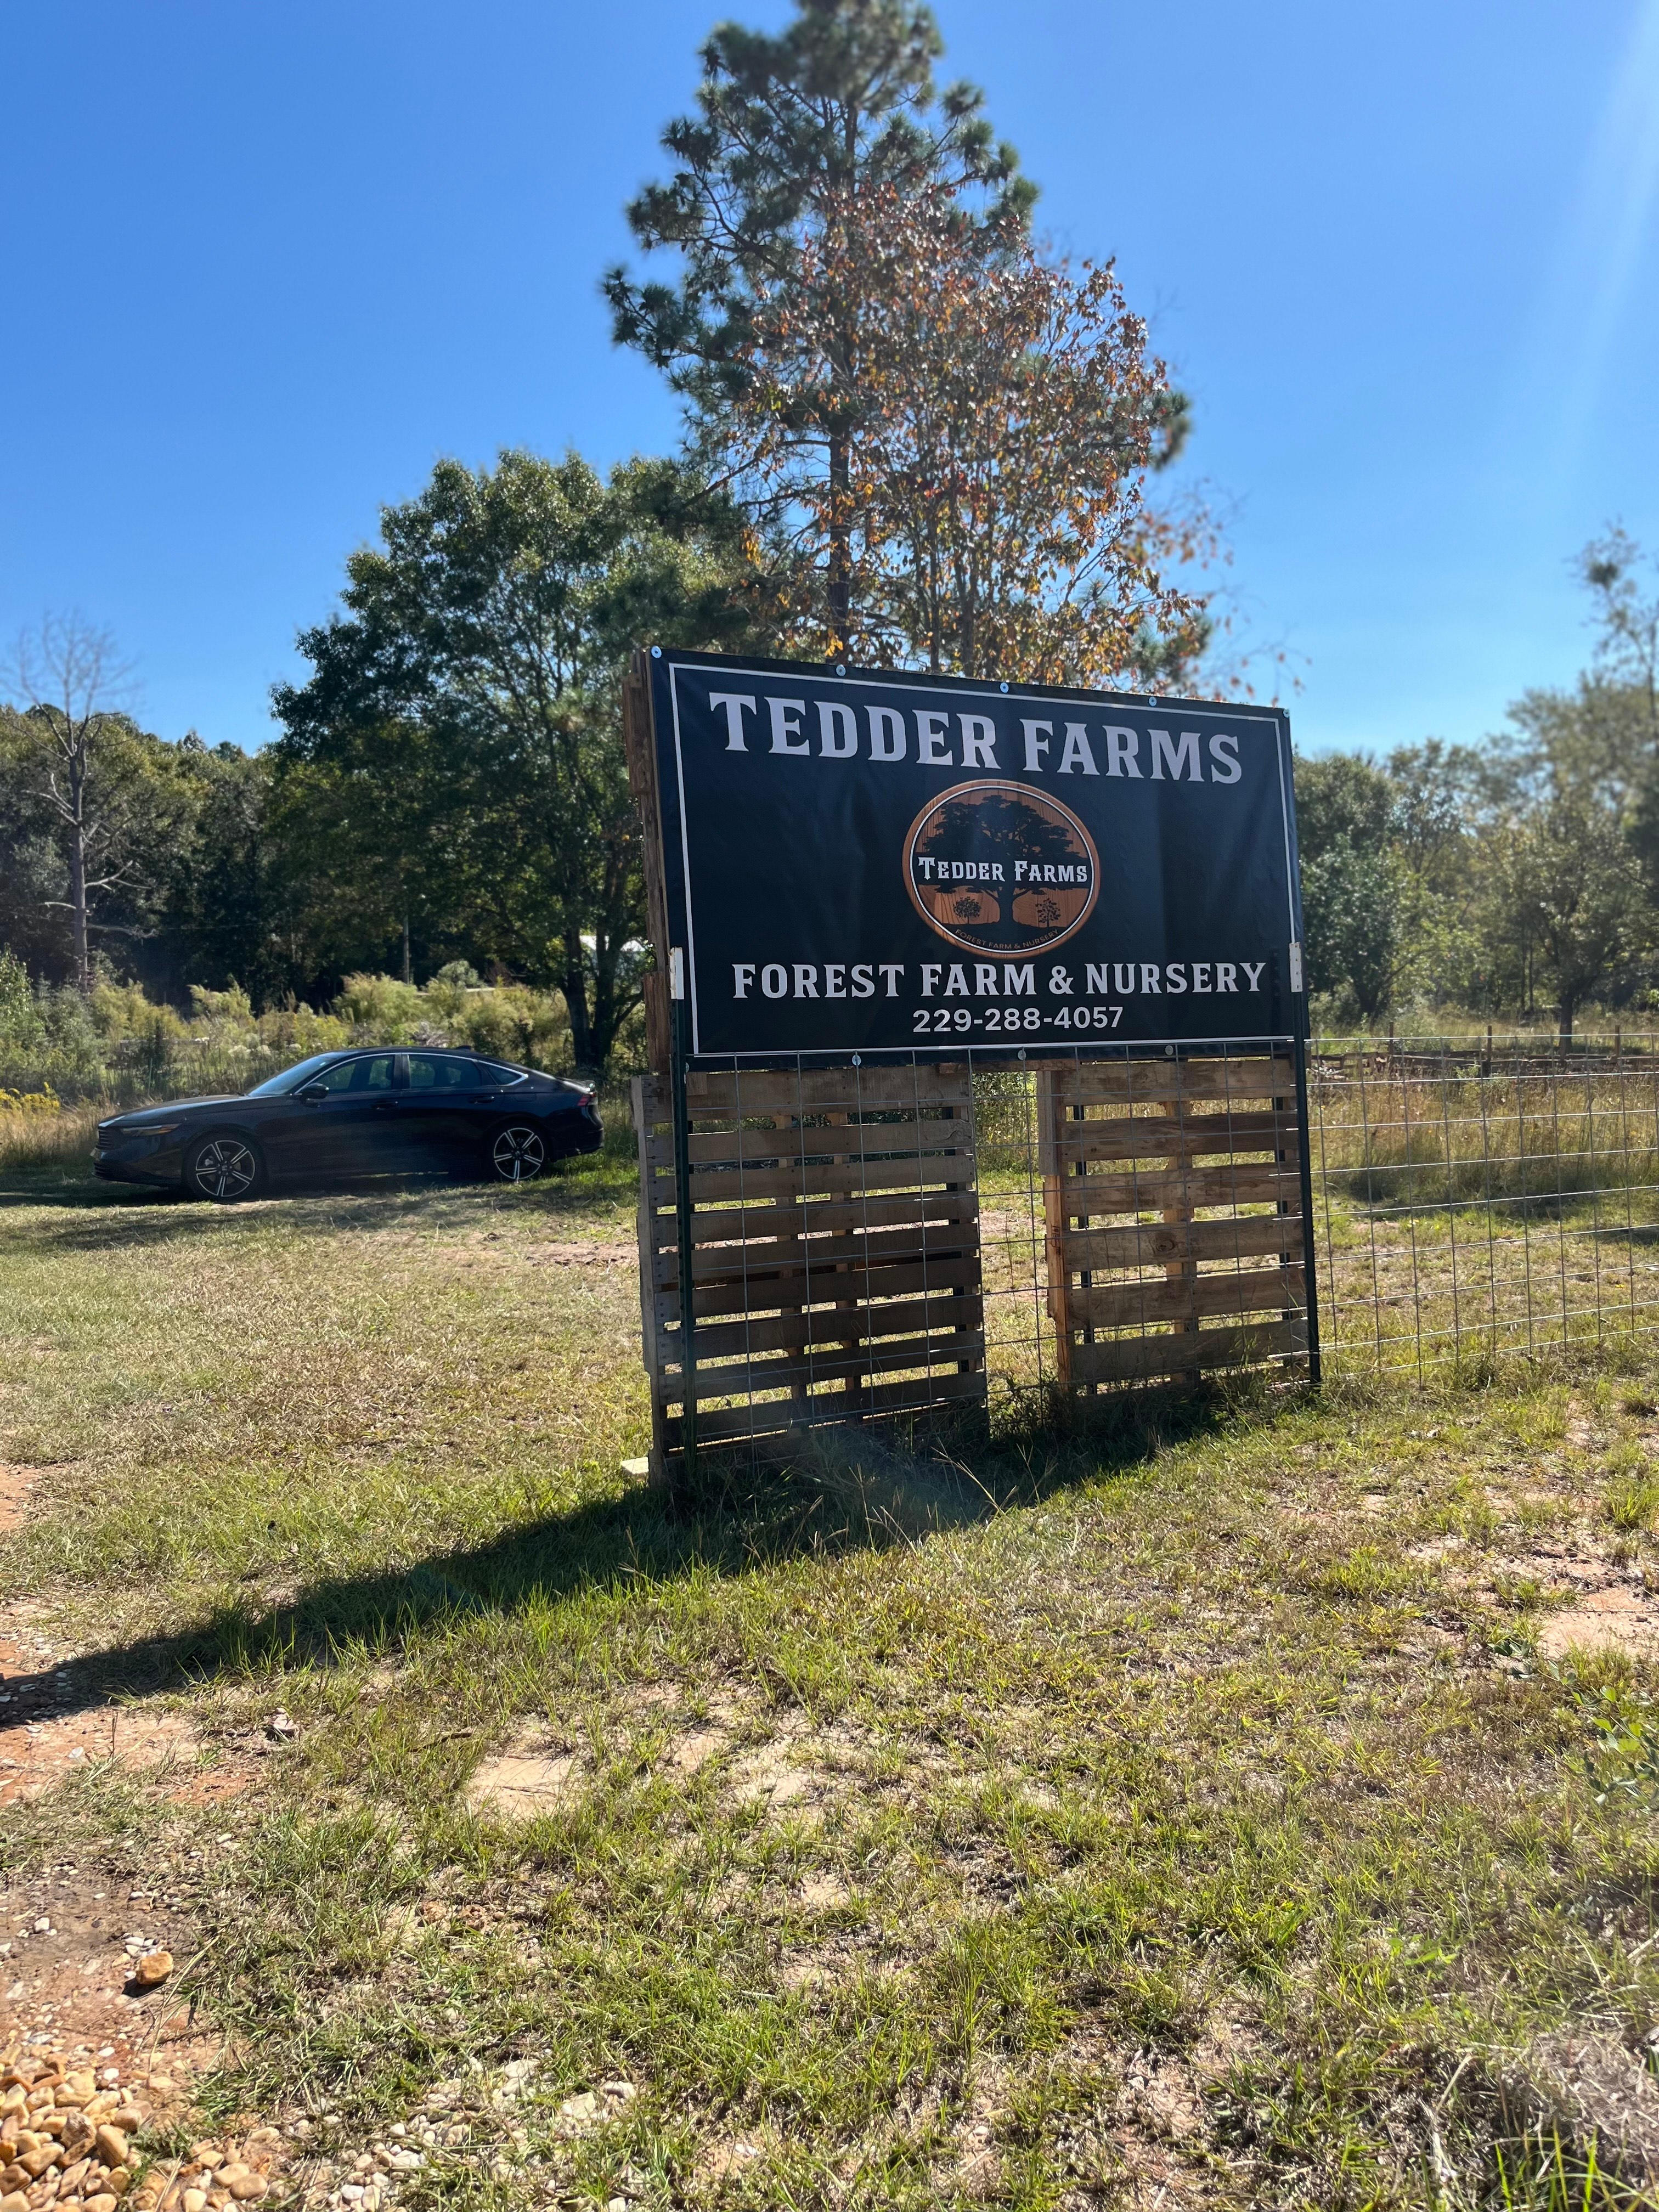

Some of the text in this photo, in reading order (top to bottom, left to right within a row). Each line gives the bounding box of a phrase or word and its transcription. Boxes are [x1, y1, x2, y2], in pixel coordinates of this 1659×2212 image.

[709, 692, 1243, 785] TEDDER FARMS
[955, 929, 987, 945] FOREST
[1023, 928, 1058, 947] NURSERY
[732, 962, 1266, 998] FOREST FARM & NURSERY
[913, 1007, 1124, 1032] 229-288-4057
